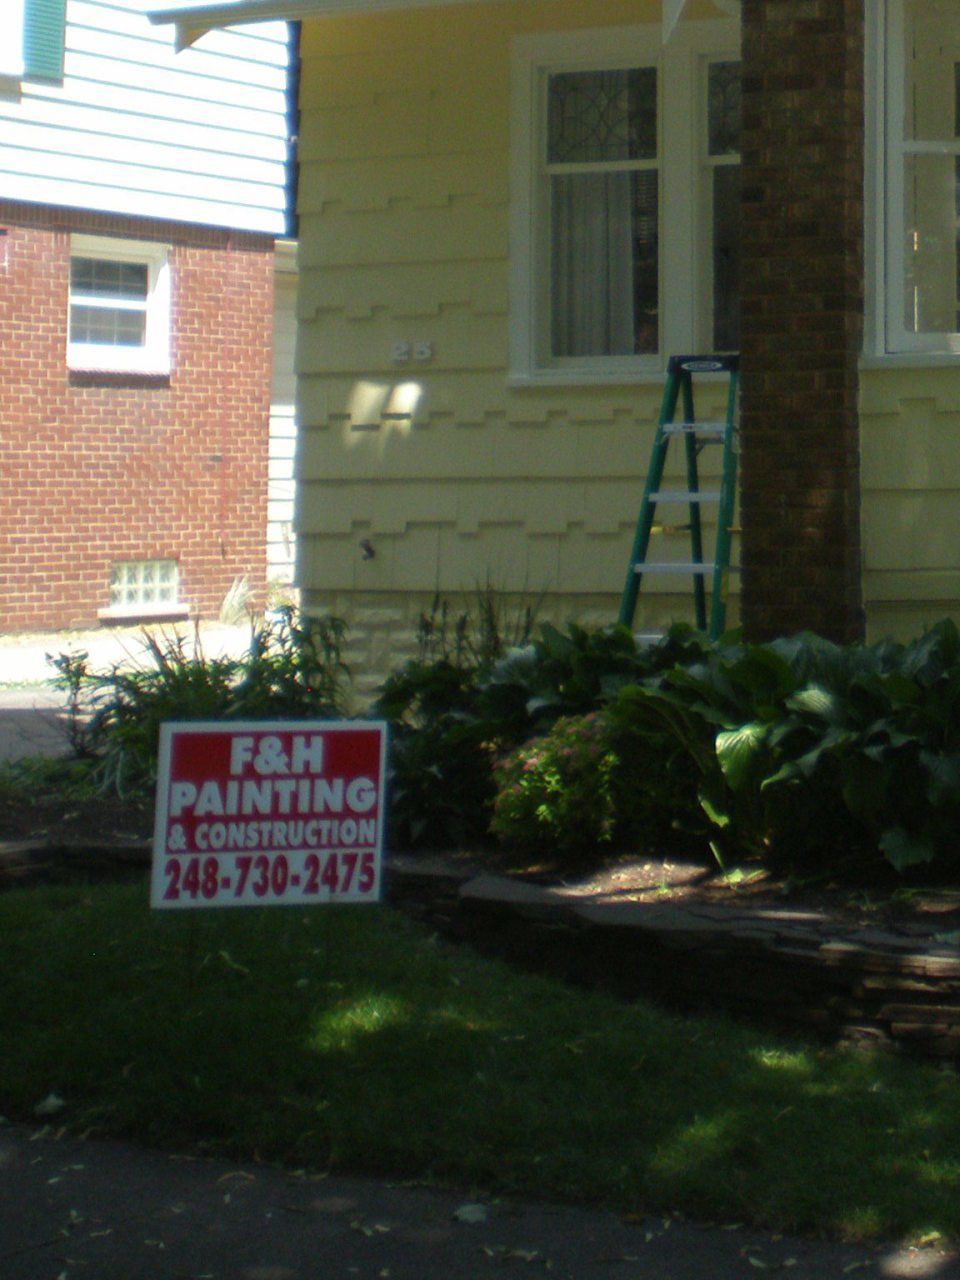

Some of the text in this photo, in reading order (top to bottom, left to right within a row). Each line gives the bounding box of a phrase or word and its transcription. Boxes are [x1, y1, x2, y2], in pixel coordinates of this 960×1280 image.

[230, 736, 324, 775] F&H
[170, 777, 376, 816] PAINTING
[168, 818, 376, 850] & CONSTRUCTION
[163, 853, 375, 900] 248-730-2475
